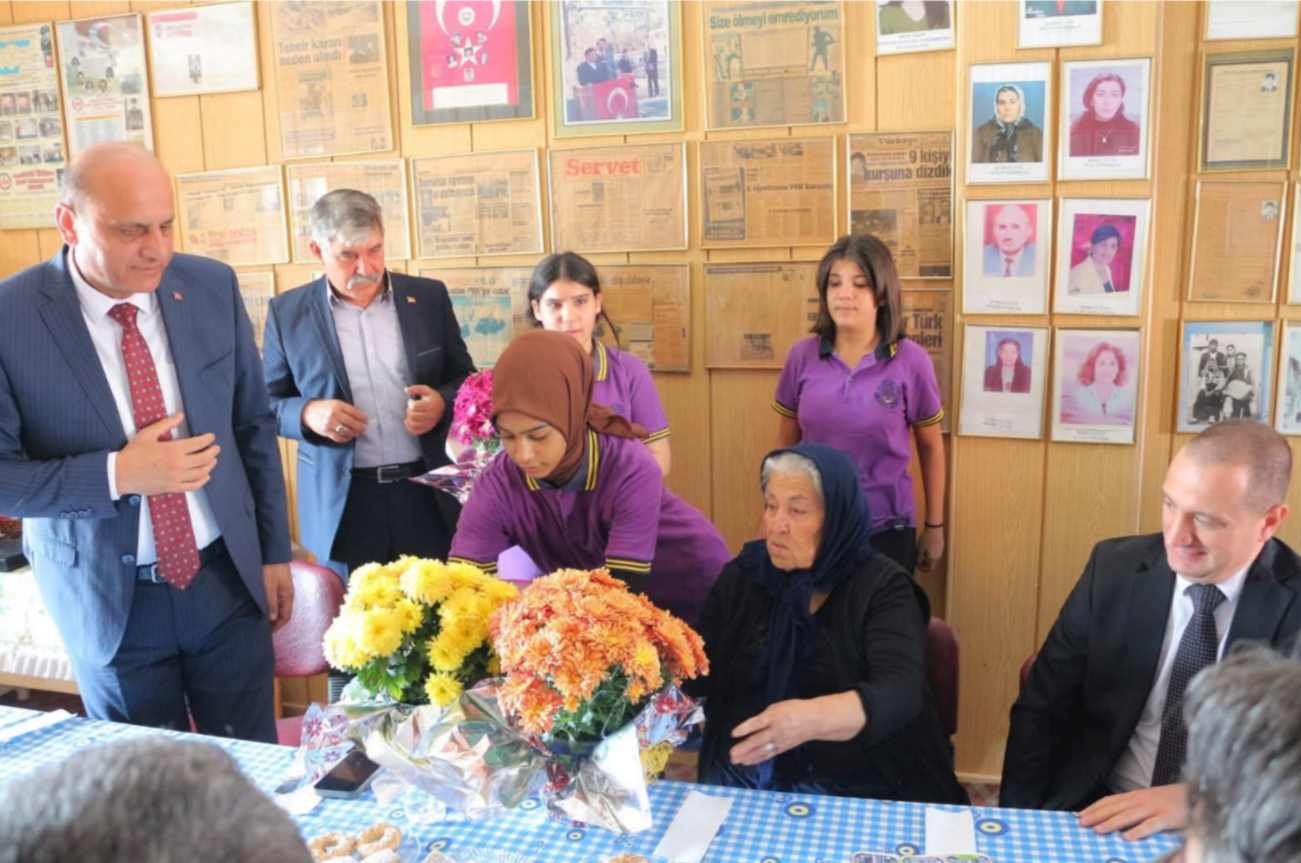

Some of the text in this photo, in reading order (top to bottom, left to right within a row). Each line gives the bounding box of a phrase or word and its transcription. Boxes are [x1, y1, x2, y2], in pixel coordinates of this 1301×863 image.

[710, 8, 838, 29] Size ölmeyi emrediyorum
[279, 53, 311, 66] neden
[909, 150, 917, 164] 9
[565, 157, 641, 176] Servet
[865, 166, 913, 181] kurşuna
[913, 313, 943, 329] Türk
